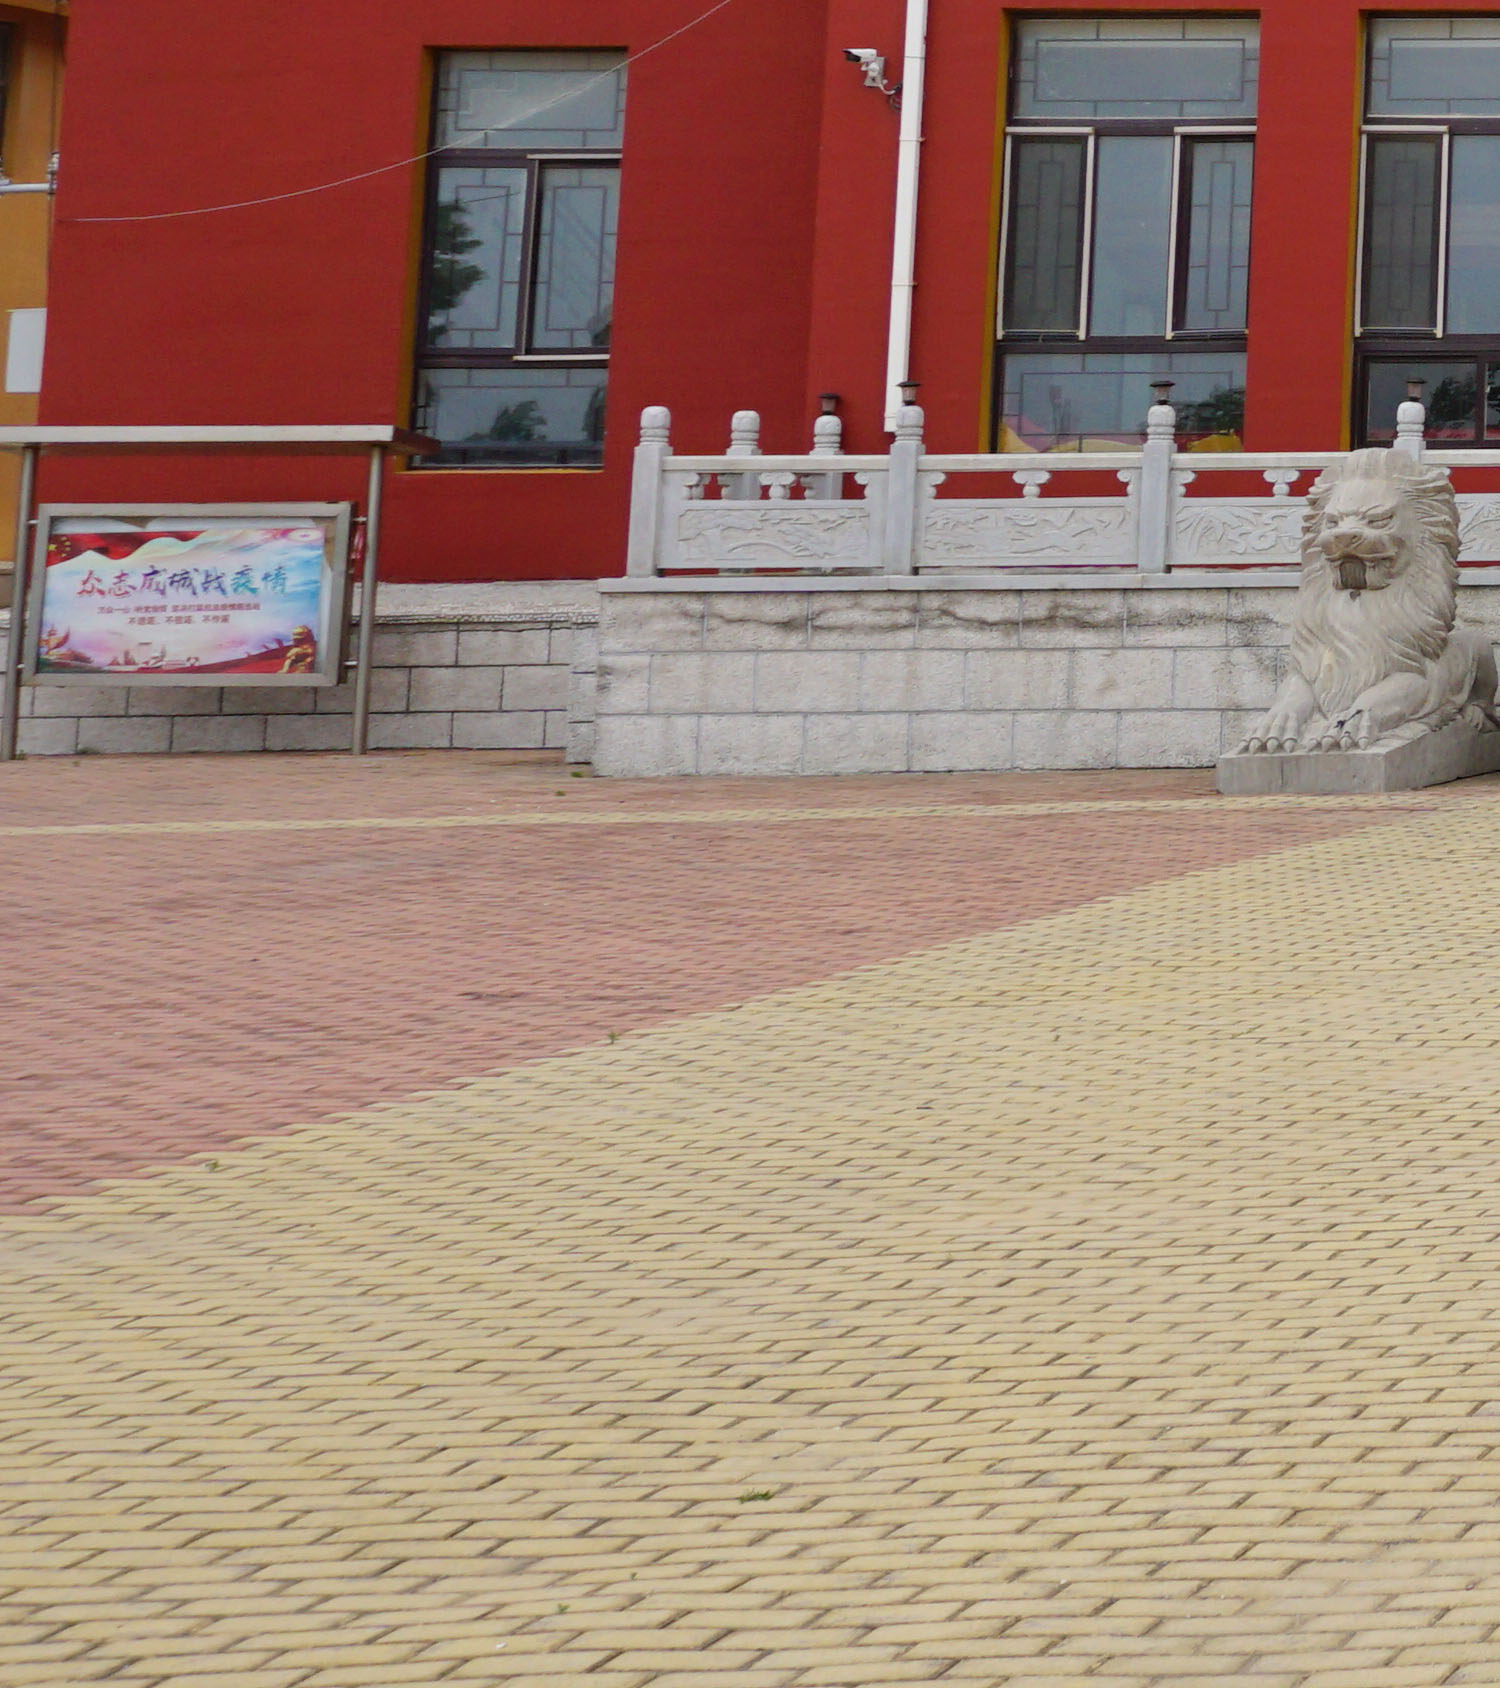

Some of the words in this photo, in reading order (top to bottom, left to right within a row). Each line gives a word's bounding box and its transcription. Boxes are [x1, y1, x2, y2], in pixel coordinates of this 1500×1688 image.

[76, 564, 290, 599] 众志成城战疫情
